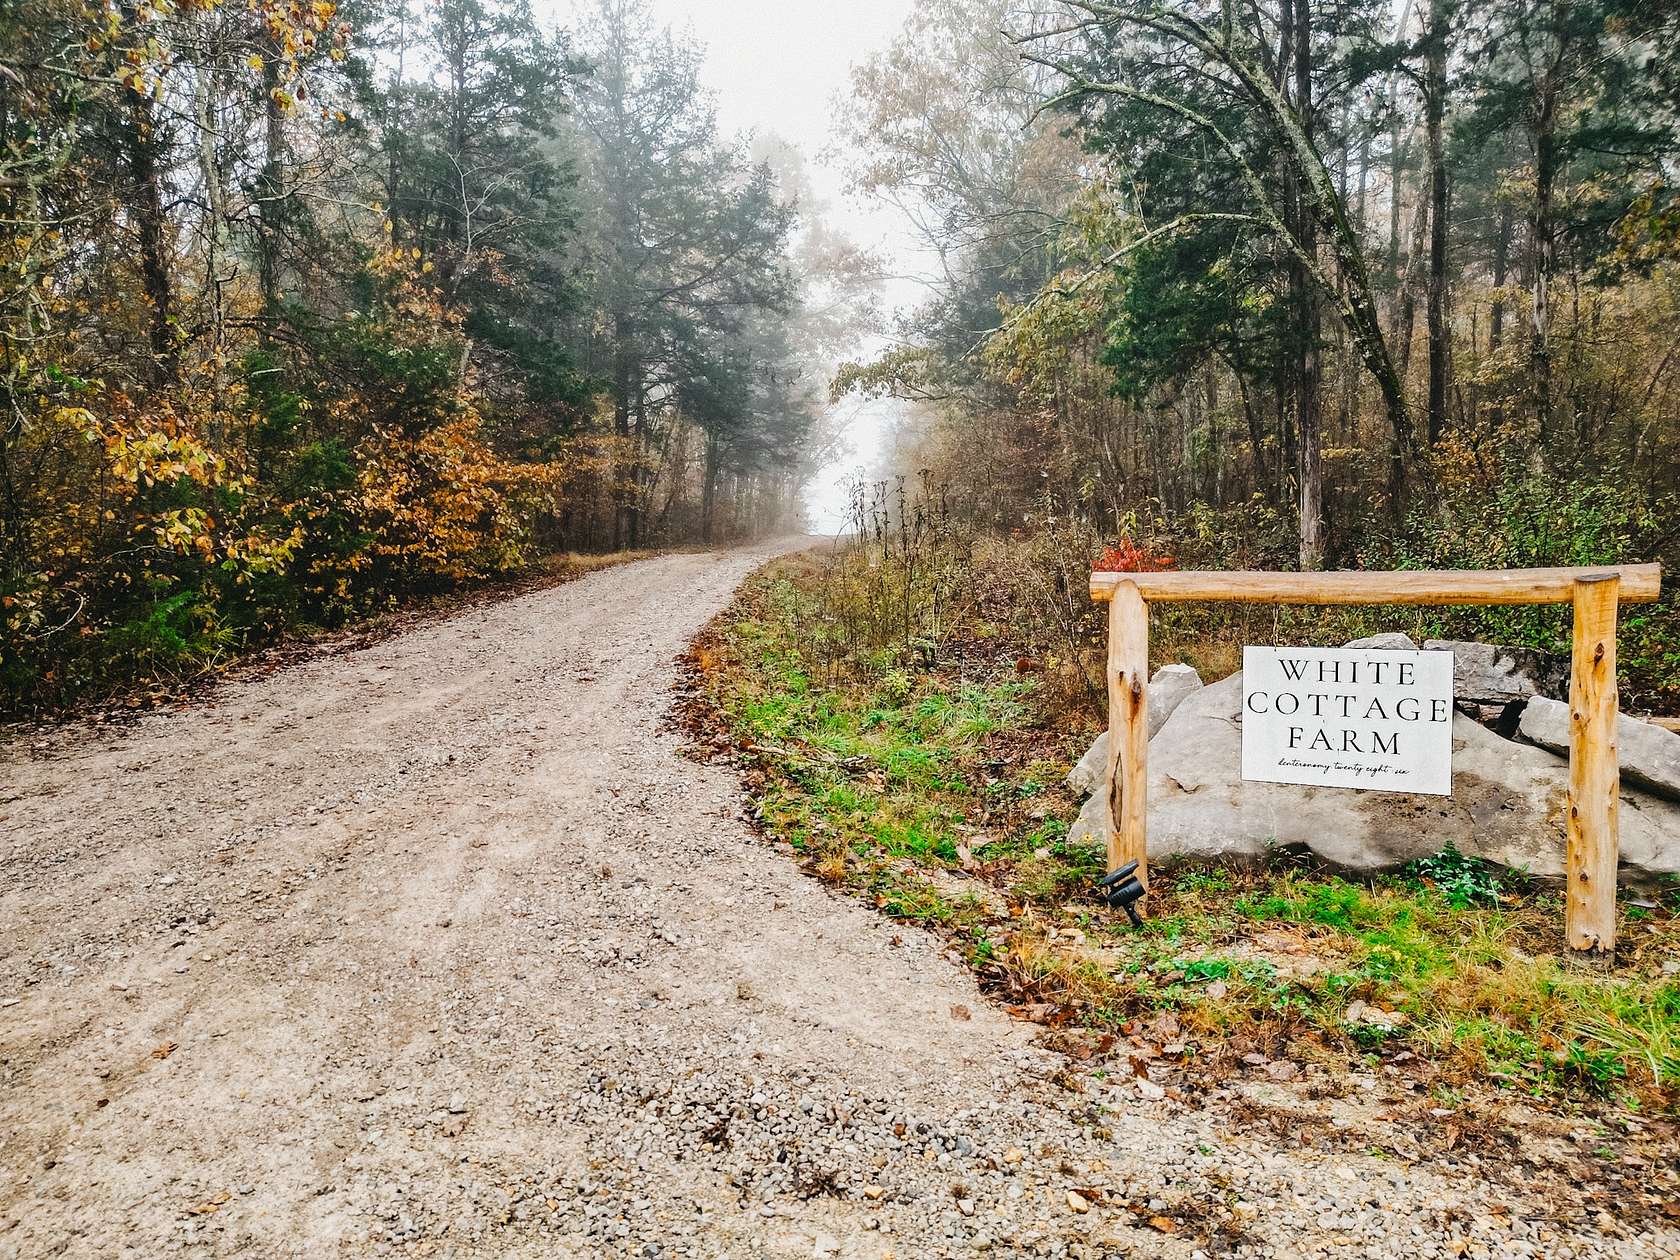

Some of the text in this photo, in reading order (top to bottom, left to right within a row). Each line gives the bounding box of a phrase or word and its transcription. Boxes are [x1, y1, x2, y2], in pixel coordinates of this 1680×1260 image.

[1278, 659, 1415, 686] WHITE
[1247, 691, 1447, 723] COTTAGE
[1288, 726, 1401, 756] FARM
[1333, 761, 1363, 777] twenty
[1366, 764, 1392, 777] eight
